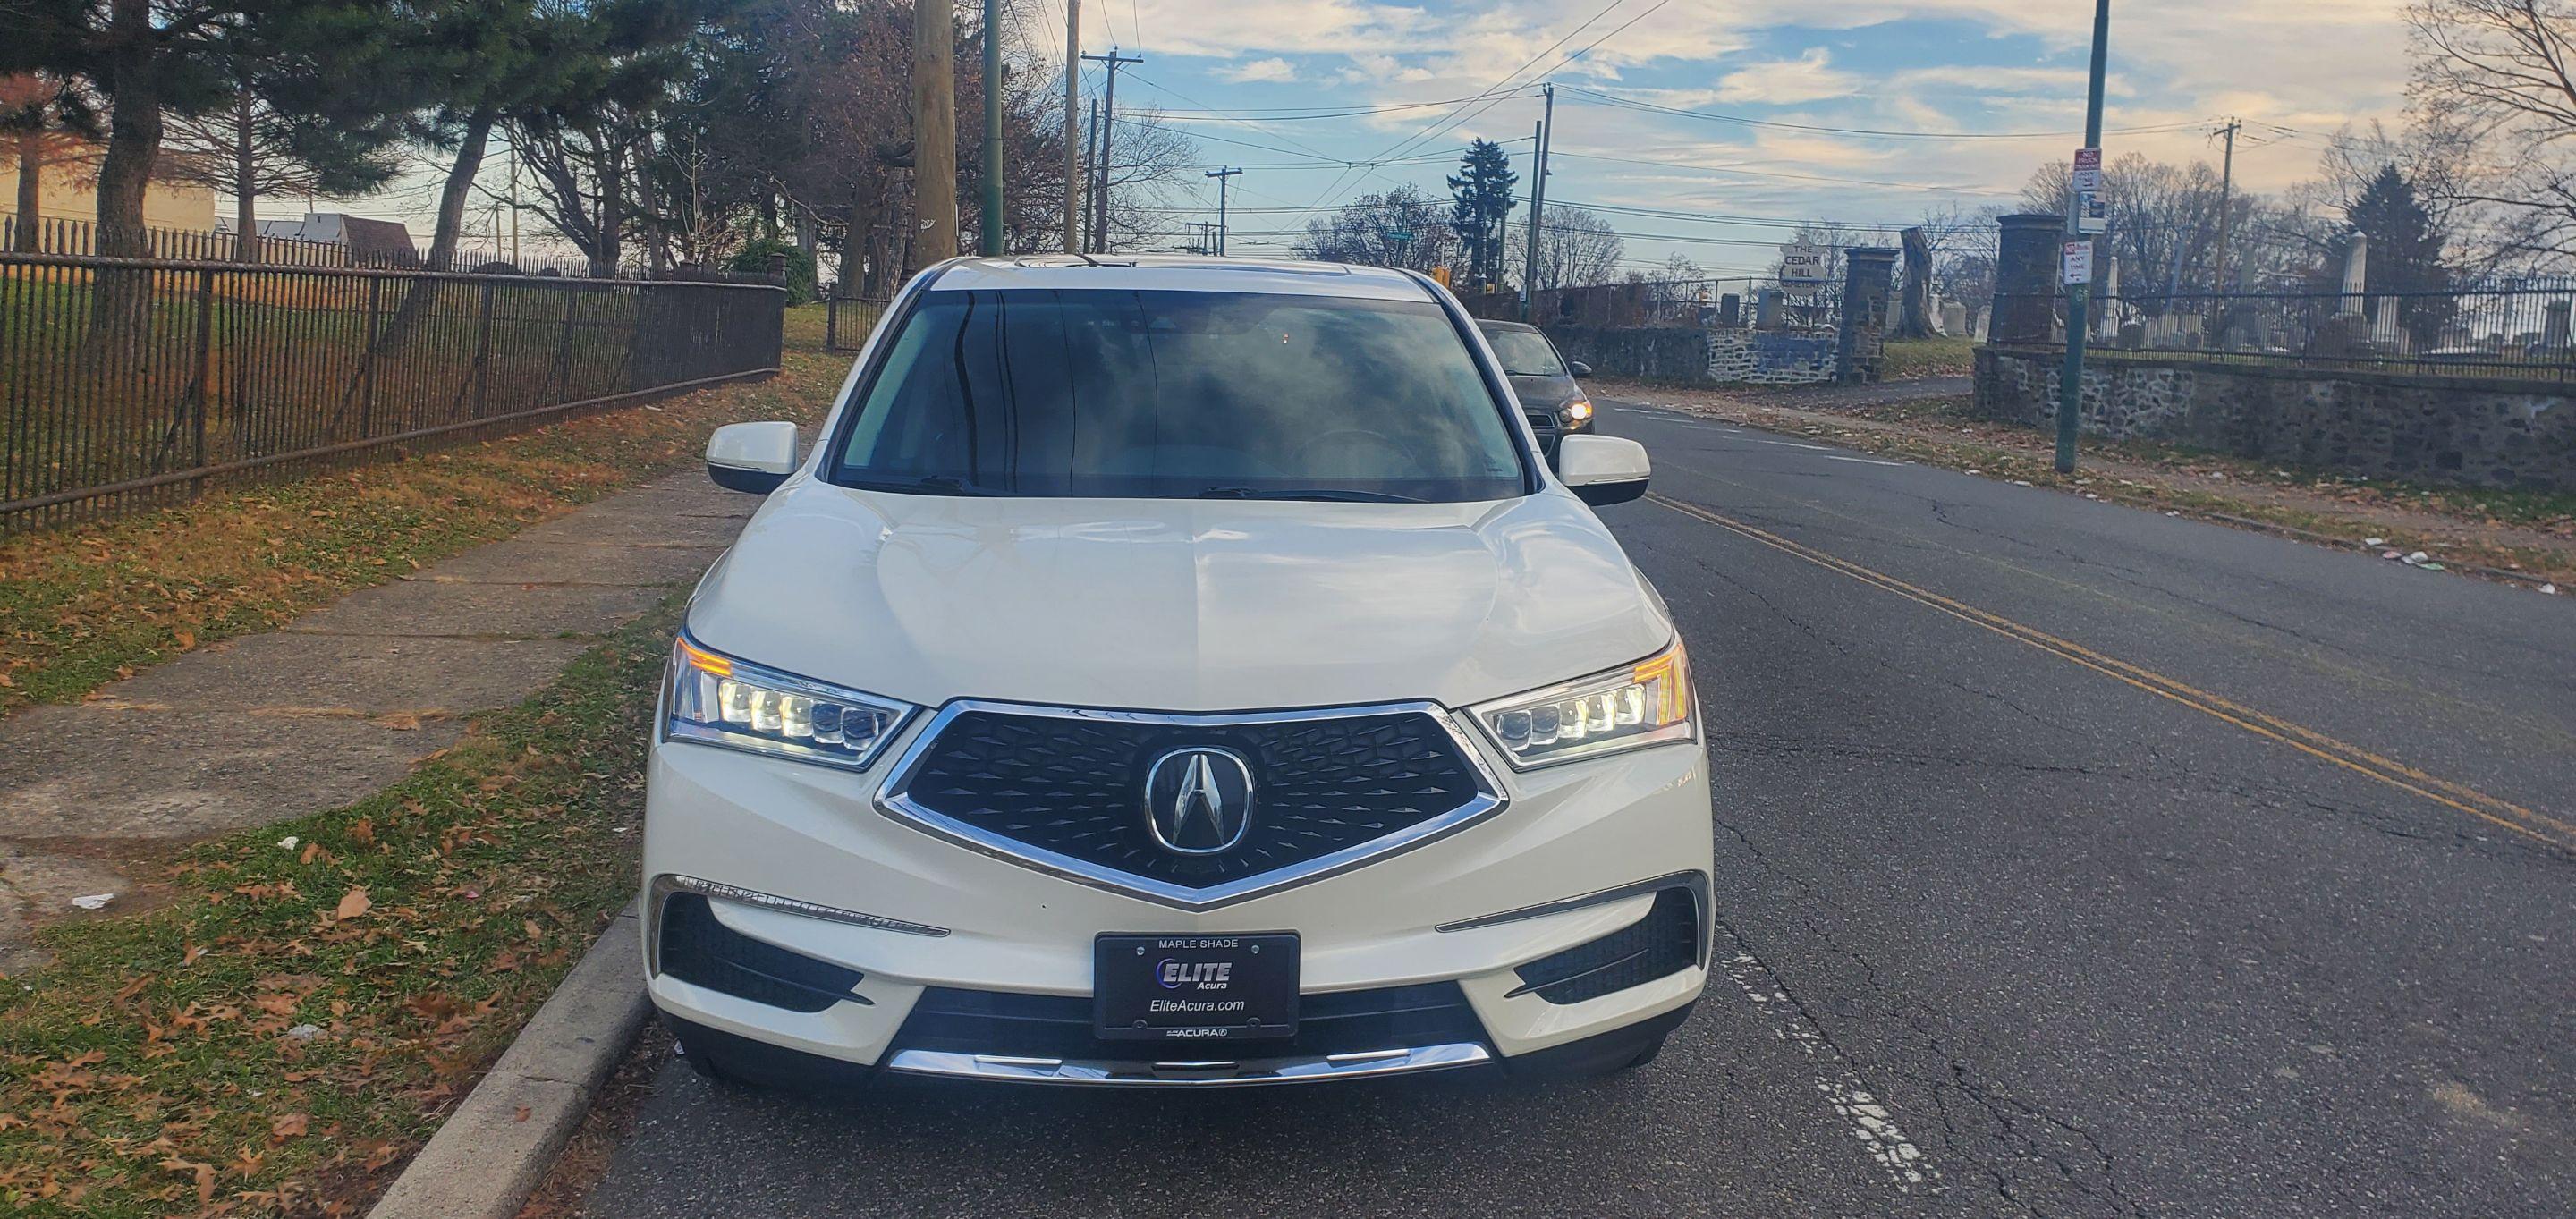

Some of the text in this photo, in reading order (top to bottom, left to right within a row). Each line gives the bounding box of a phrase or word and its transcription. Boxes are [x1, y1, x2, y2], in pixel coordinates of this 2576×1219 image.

[1784, 256, 1819, 266] CEDAR
[1792, 268, 1813, 277] HILL
[1159, 939, 1239, 948] MAPLE SHADE
[1163, 962, 1232, 982] ELITE
[1197, 982, 1227, 990] Acura
[1150, 999, 1245, 1012] EliteAcura.com
